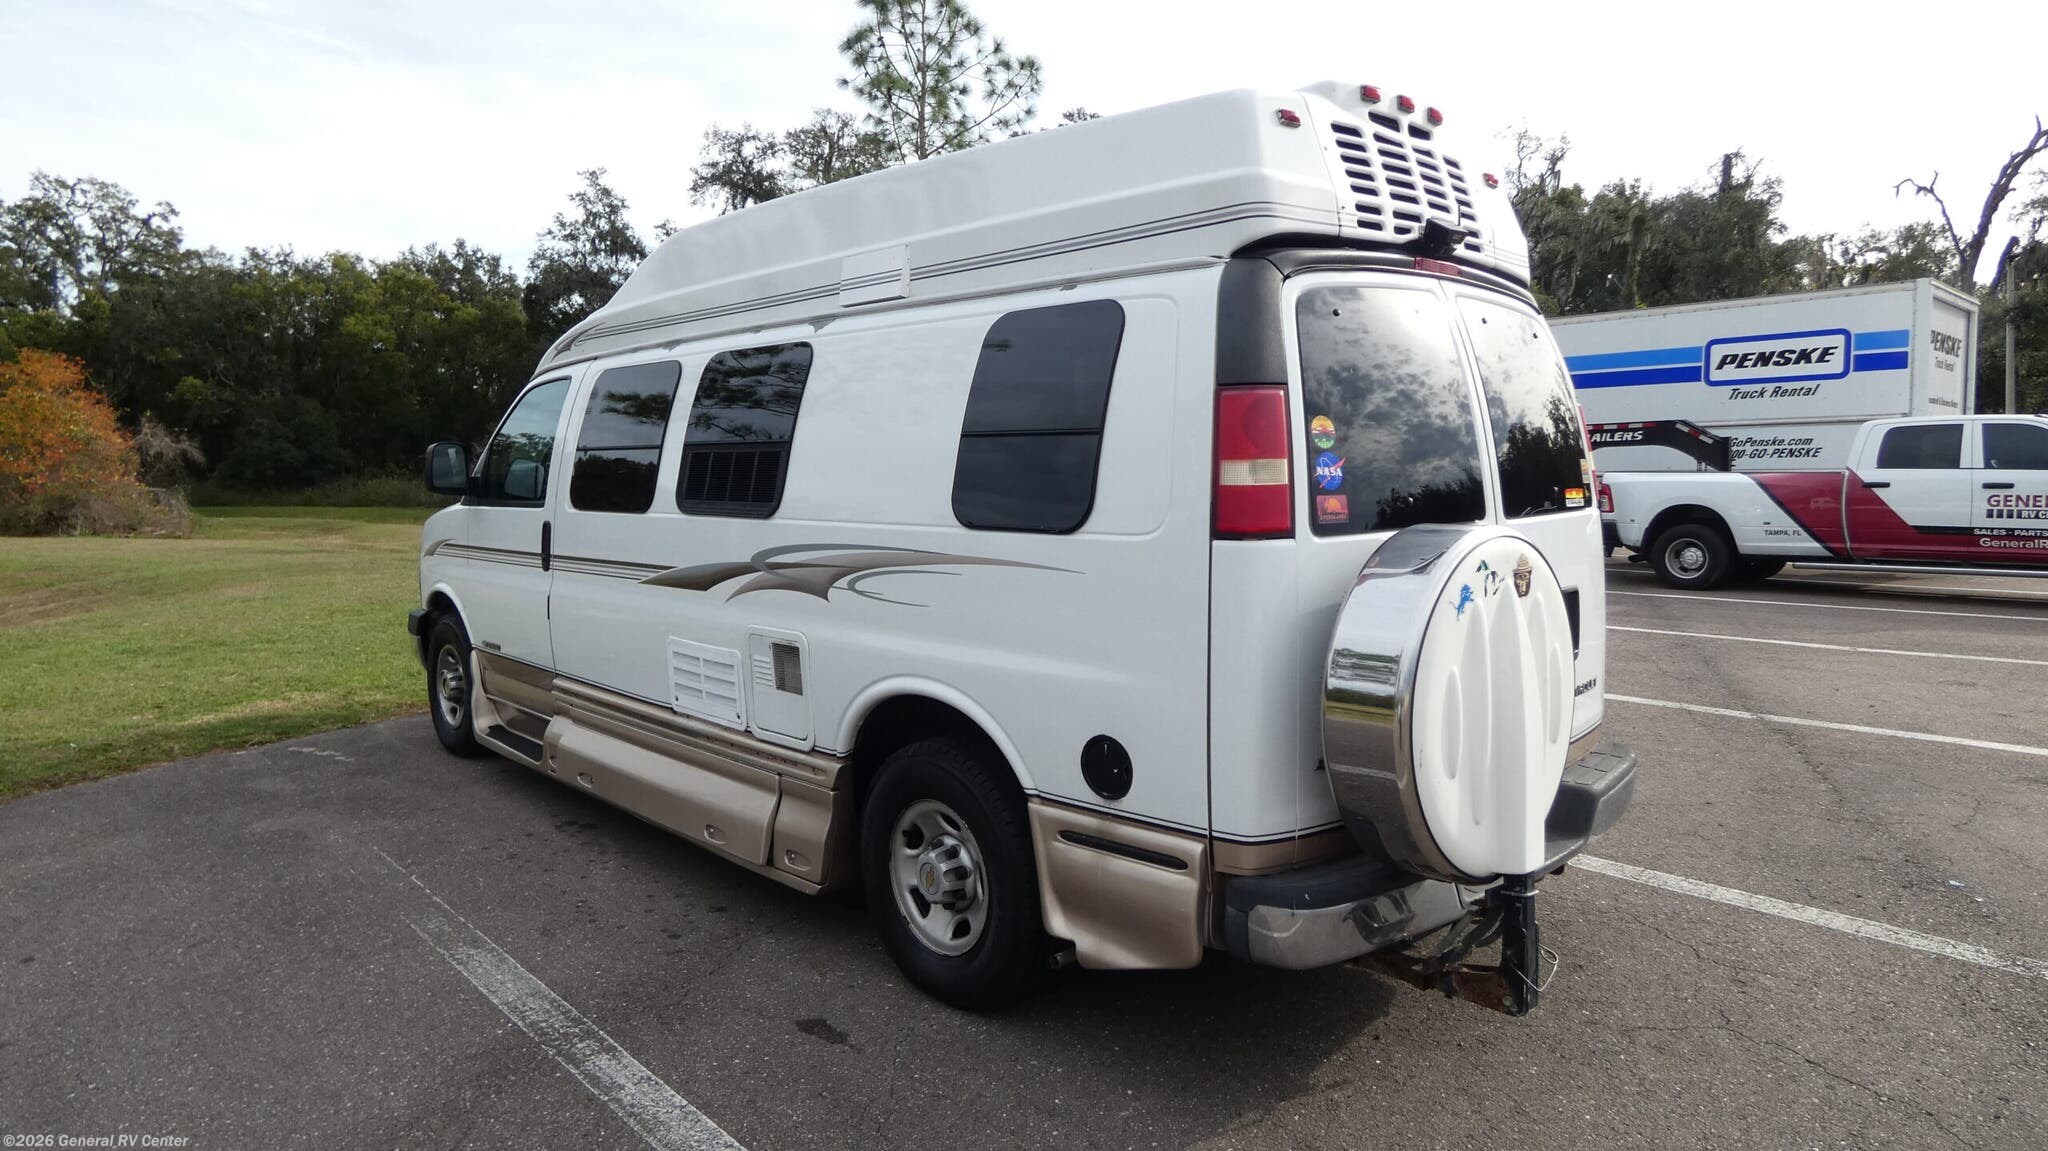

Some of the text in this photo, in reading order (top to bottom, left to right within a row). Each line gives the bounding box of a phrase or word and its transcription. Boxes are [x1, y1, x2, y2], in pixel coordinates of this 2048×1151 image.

[1930, 329, 1962, 358] PENSKE
[1715, 346, 1839, 370] PENSKE
[1728, 384, 1820, 400] Truck Rental
[1730, 436, 1814, 448] GoPenske.com
[1315, 466, 1343, 477] NASA
[1987, 494, 2048, 508] GENE
[2021, 510, 2036, 519] RV
[1973, 528, 2007, 536] SALES
[2014, 529, 2048, 537] PARTS
